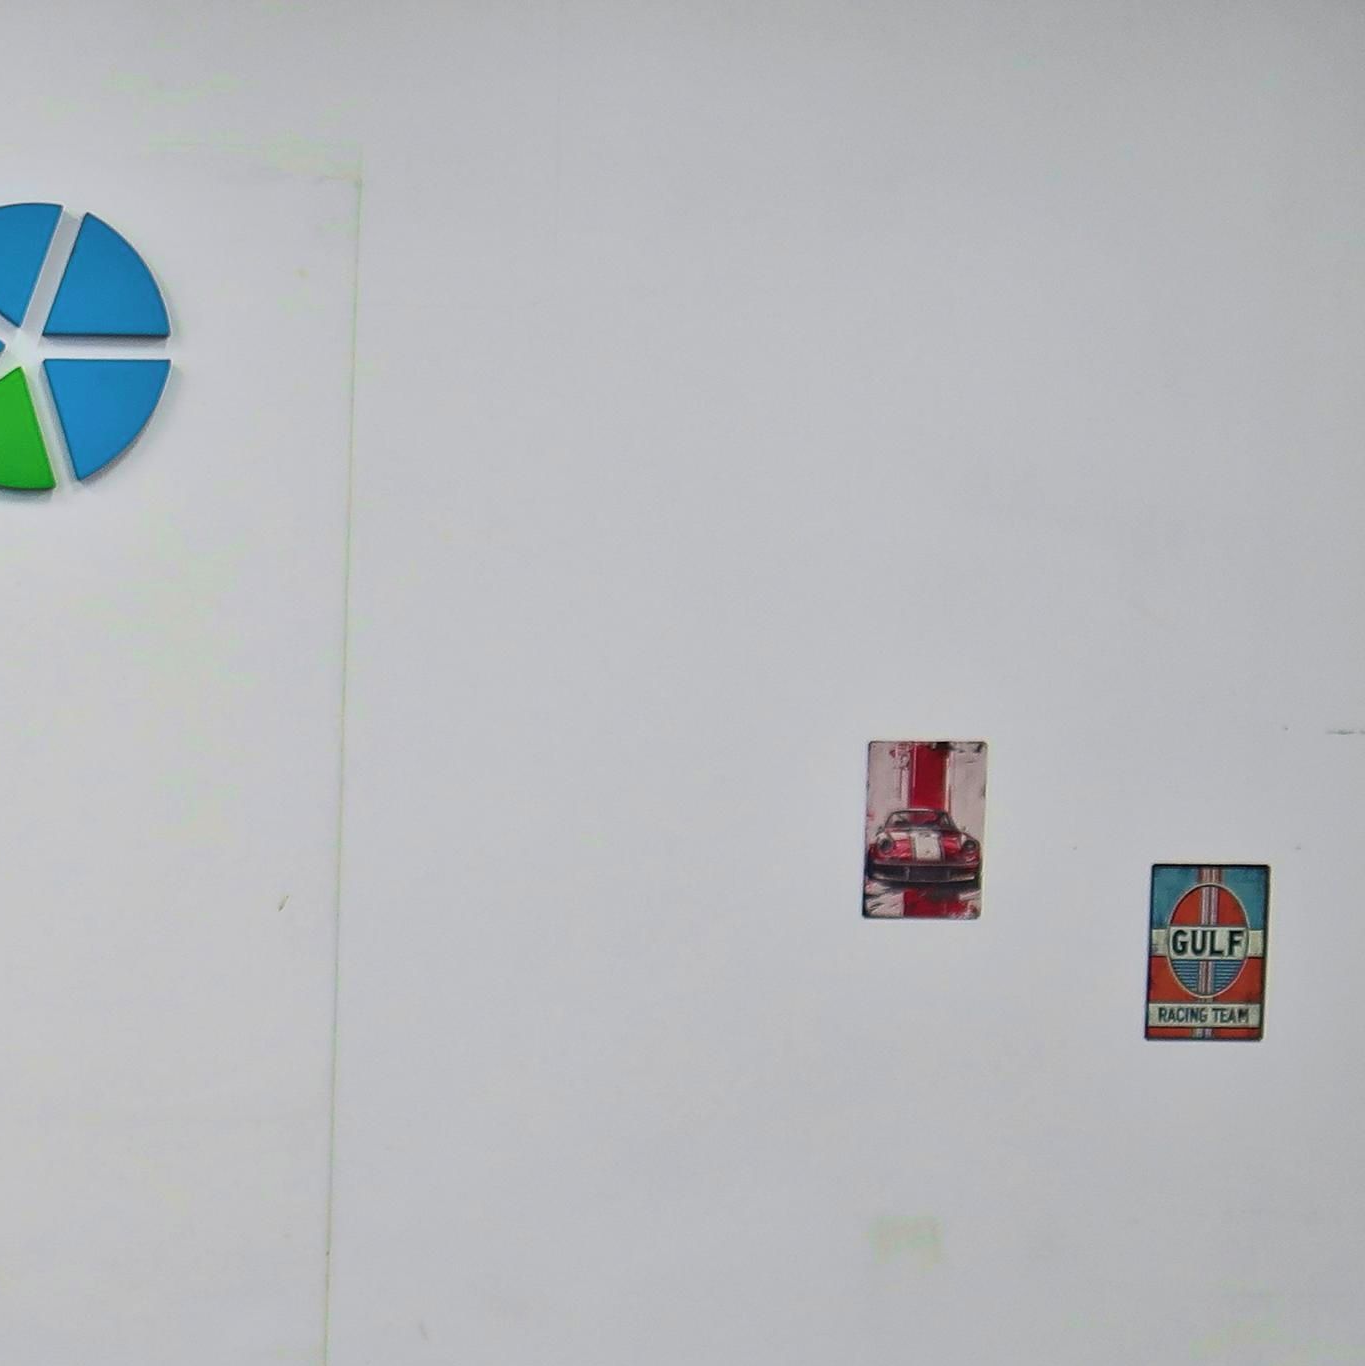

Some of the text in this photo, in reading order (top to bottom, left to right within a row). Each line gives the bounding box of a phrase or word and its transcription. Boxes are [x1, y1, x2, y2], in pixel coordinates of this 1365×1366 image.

[1171, 929, 1245, 956] GULF
[1158, 1006, 1250, 1024] RACING TEAM
